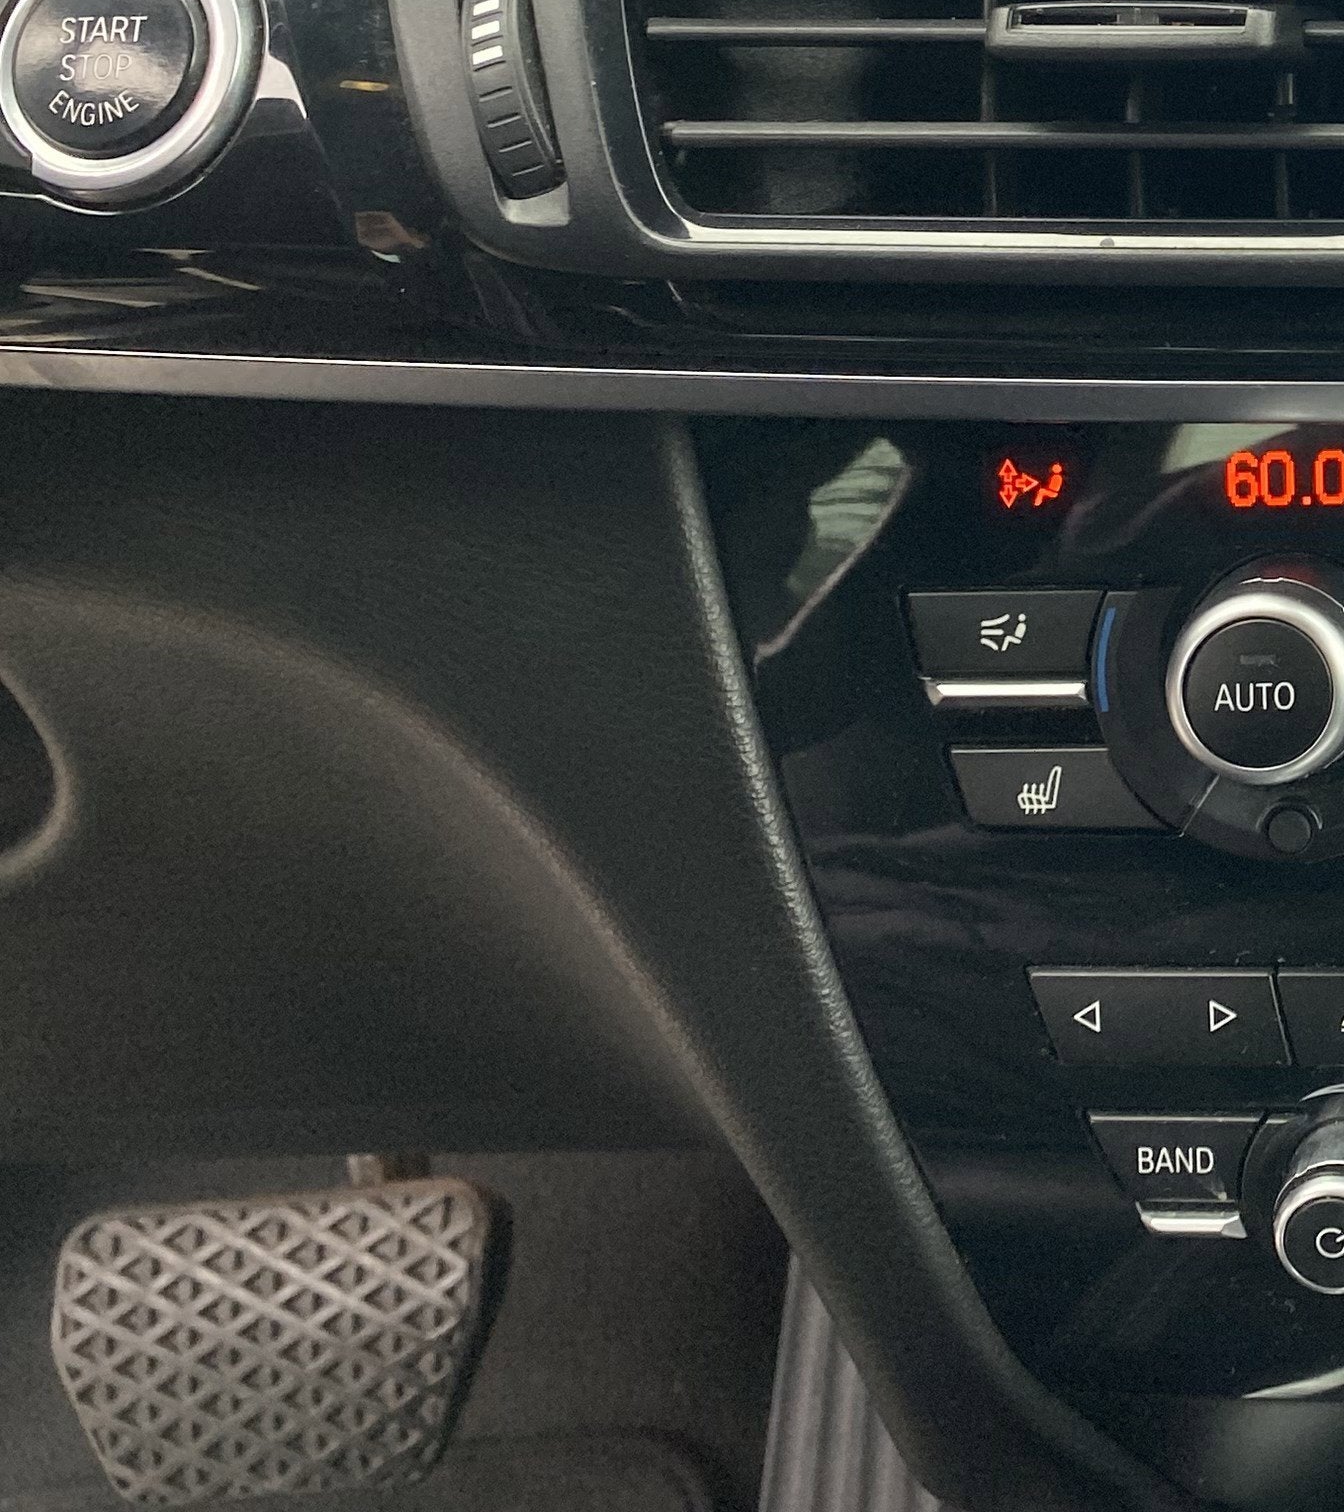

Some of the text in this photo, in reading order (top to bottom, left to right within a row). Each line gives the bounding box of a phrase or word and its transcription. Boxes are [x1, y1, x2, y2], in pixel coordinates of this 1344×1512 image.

[60, 16, 148, 44] START
[59, 54, 133, 82] STOP
[48, 89, 140, 126] ENGINE
[1214, 682, 1295, 712] AUTO
[1136, 1147, 1214, 1174] BAND
